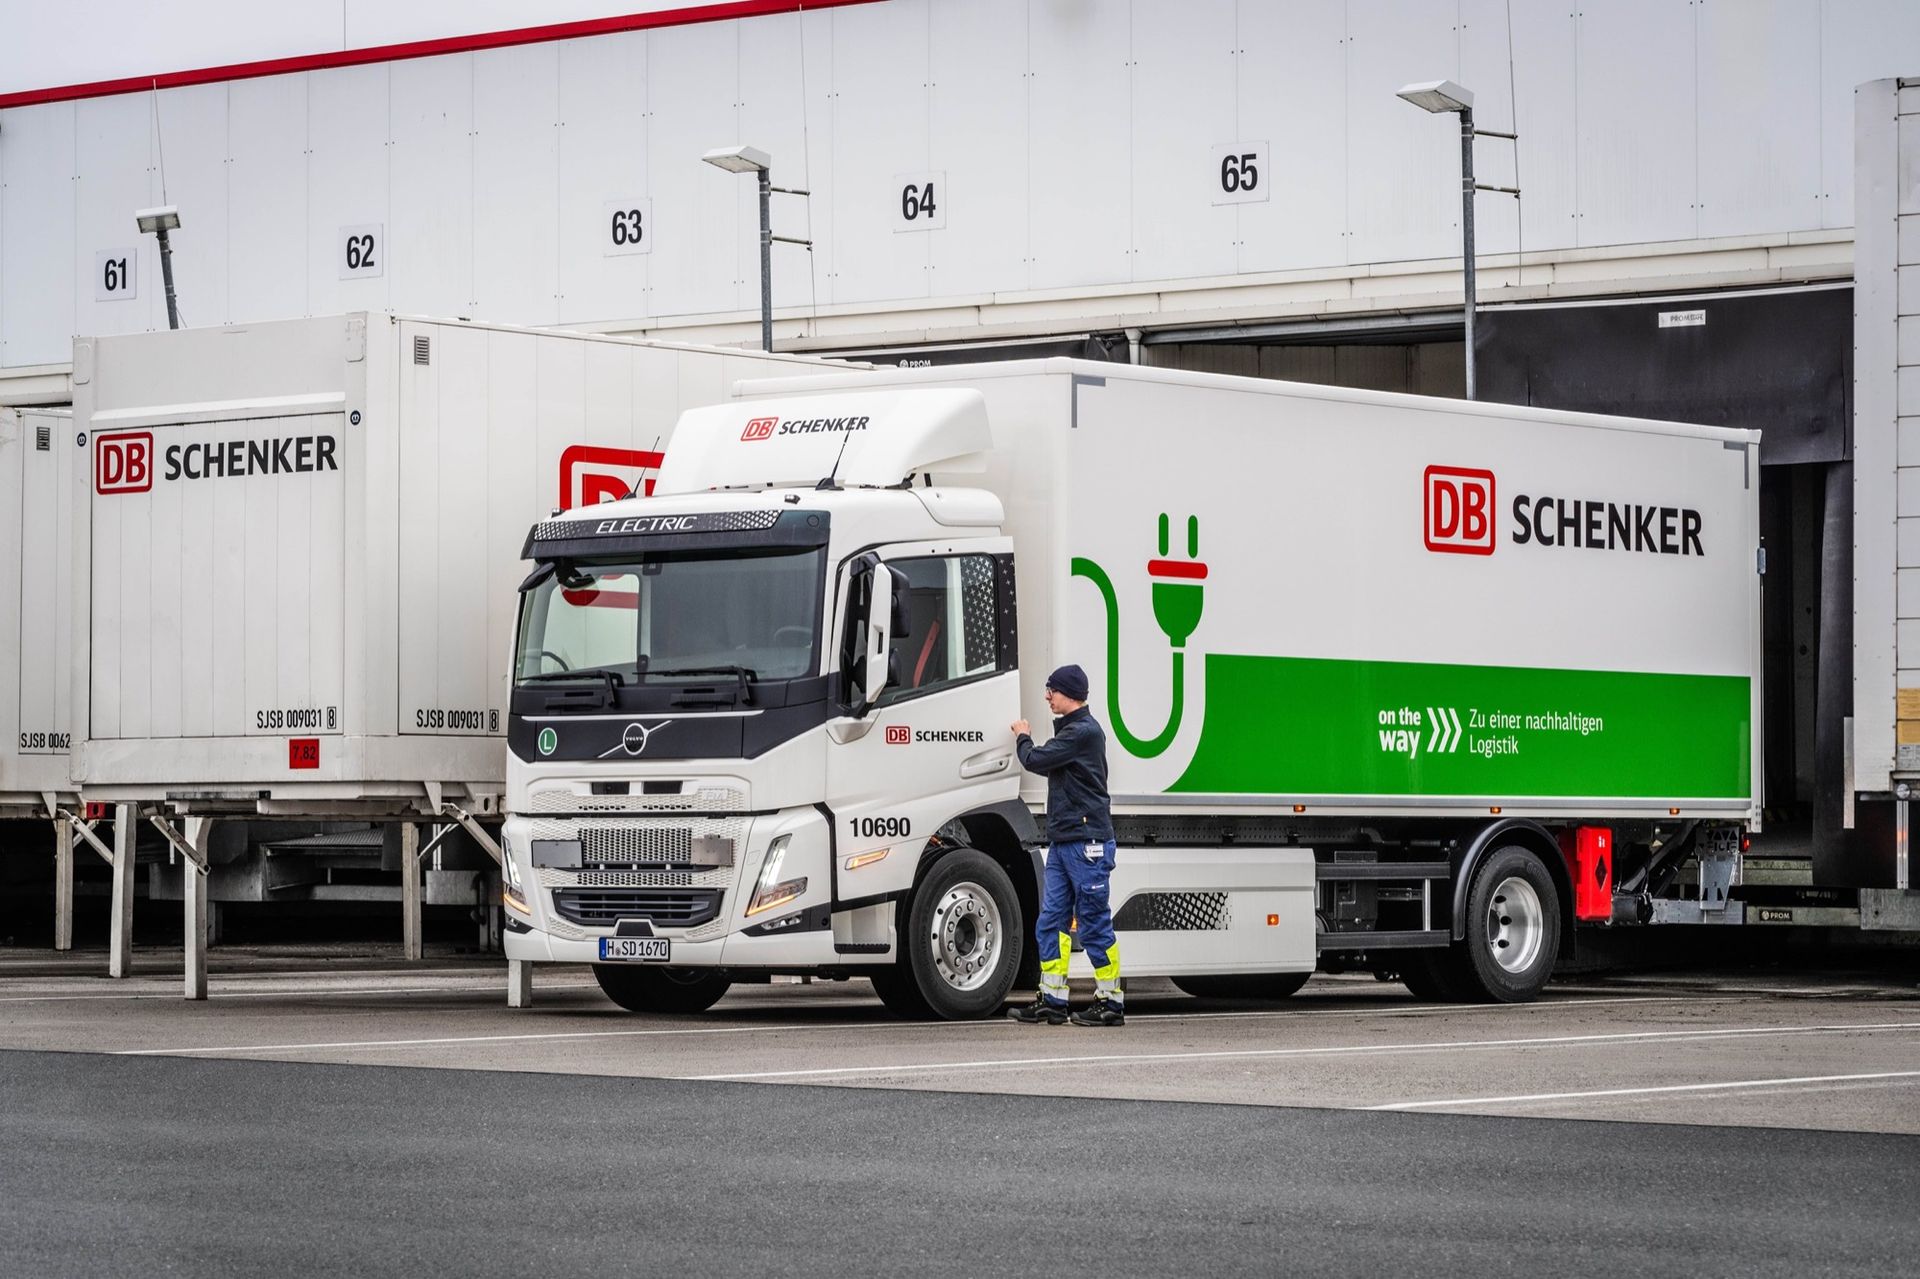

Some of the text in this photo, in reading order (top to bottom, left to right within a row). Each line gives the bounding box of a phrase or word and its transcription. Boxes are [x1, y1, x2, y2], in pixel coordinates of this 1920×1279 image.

[1222, 154, 1257, 192] 65
[903, 183, 936, 220] 64
[612, 210, 642, 245] 63
[347, 235, 374, 269] 62
[105, 258, 126, 291] 61
[745, 416, 870, 439] DB SCHENKER
[103, 436, 338, 485] DB SCHENKER
[595, 515, 698, 534] ELECTRIC
[1433, 480, 1704, 556] DB SCHENKER
[257, 708, 335, 728] SJSB 009031 8
[417, 709, 497, 730] SJSB 009031 8
[1379, 707, 1422, 725] on the
[1469, 708, 1602, 735] Zu einer nachhaltigen
[21, 733, 45, 748] SJSB
[543, 733, 552, 750] L
[889, 729, 984, 742] DB SCHENKER
[1379, 731, 1421, 759] way
[1470, 735, 1518, 758] Logistik
[850, 817, 911, 838] 10690
[607, 941, 615, 956] H
